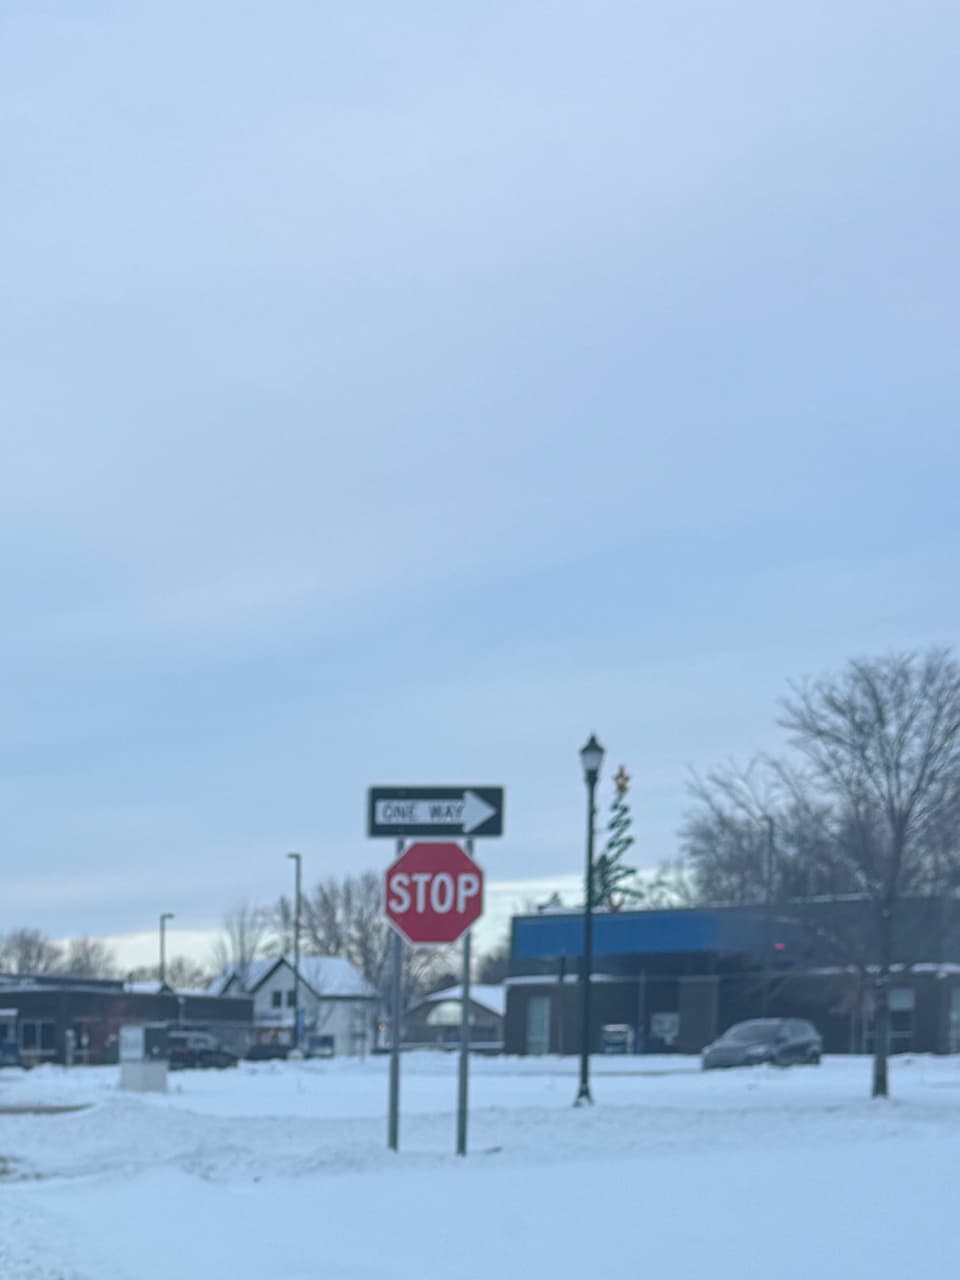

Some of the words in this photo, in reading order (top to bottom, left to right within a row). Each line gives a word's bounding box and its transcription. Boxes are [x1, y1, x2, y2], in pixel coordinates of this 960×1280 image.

[382, 804, 415, 819] ONE
[429, 804, 463, 819] WAY
[388, 872, 480, 914] STOP
